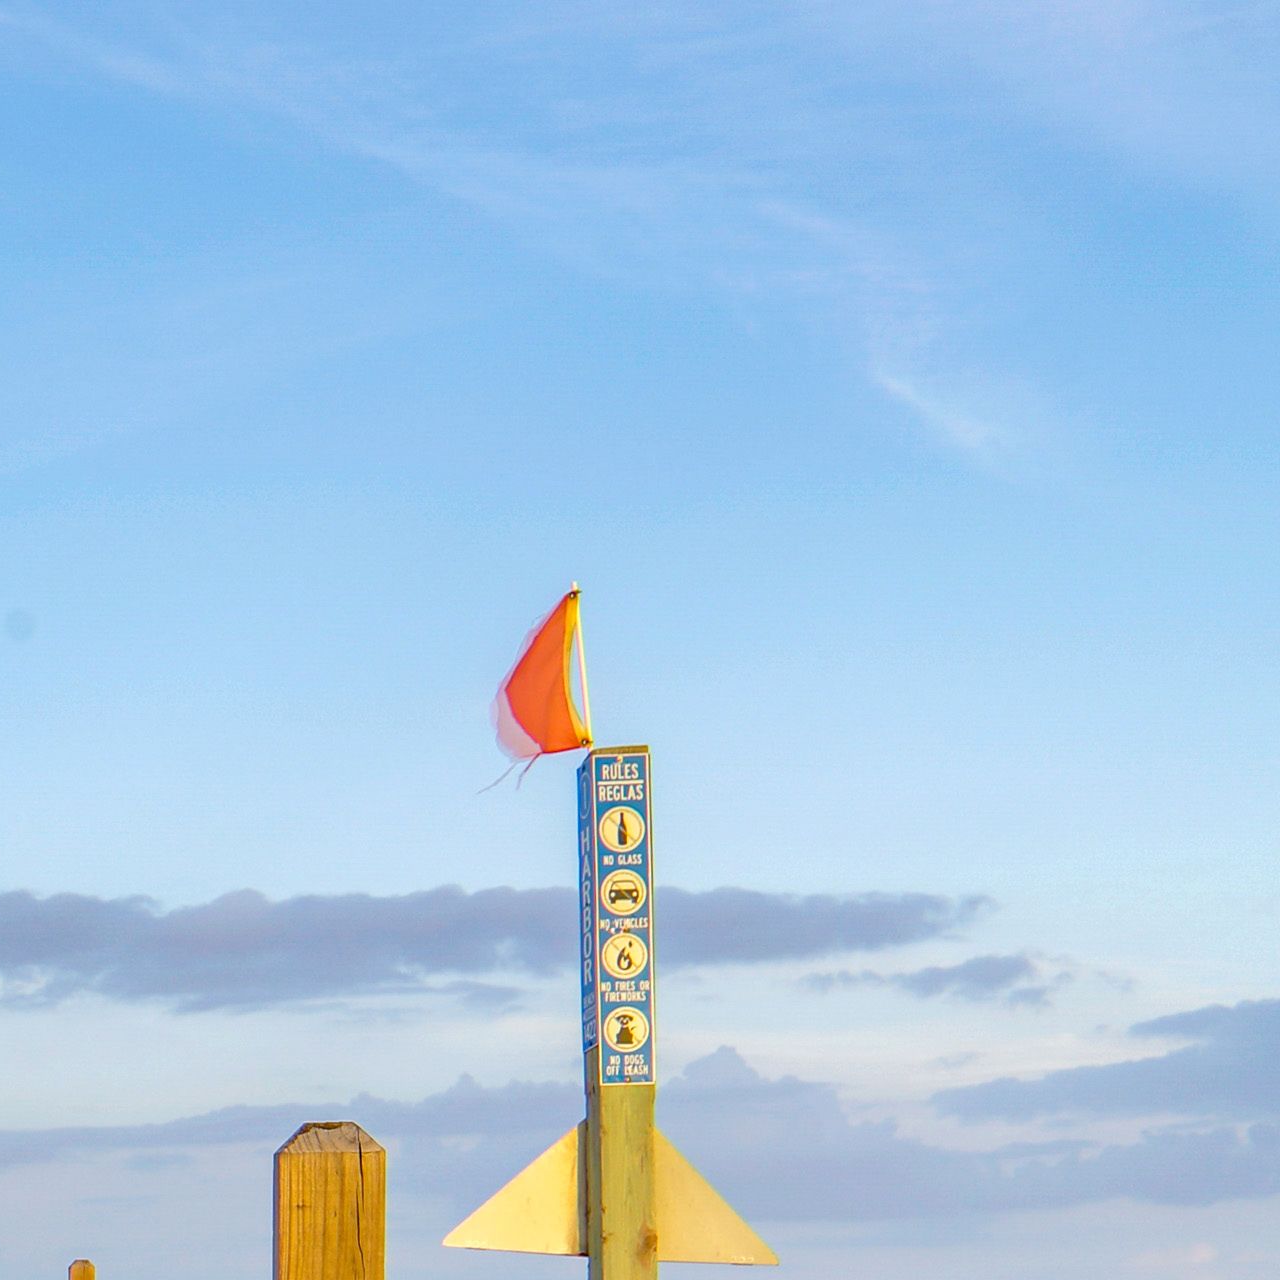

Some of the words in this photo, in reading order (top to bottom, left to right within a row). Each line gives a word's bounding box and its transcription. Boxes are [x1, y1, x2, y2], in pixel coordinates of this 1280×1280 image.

[602, 764, 639, 780] RULES
[598, 785, 644, 801] REGLAS
[603, 855, 614, 866] NO
[618, 854, 642, 865] GLASS
[614, 917, 648, 929] VEHICLES
[601, 981, 612, 992] NO
[615, 980, 636, 991] FIRES
[639, 979, 650, 991] OR
[605, 991, 647, 1002] FIREWORKS
[609, 1055, 620, 1065] NO
[624, 1054, 644, 1065] DOGS
[606, 1065, 620, 1076] OFF
[624, 1064, 648, 1076] LEASH
